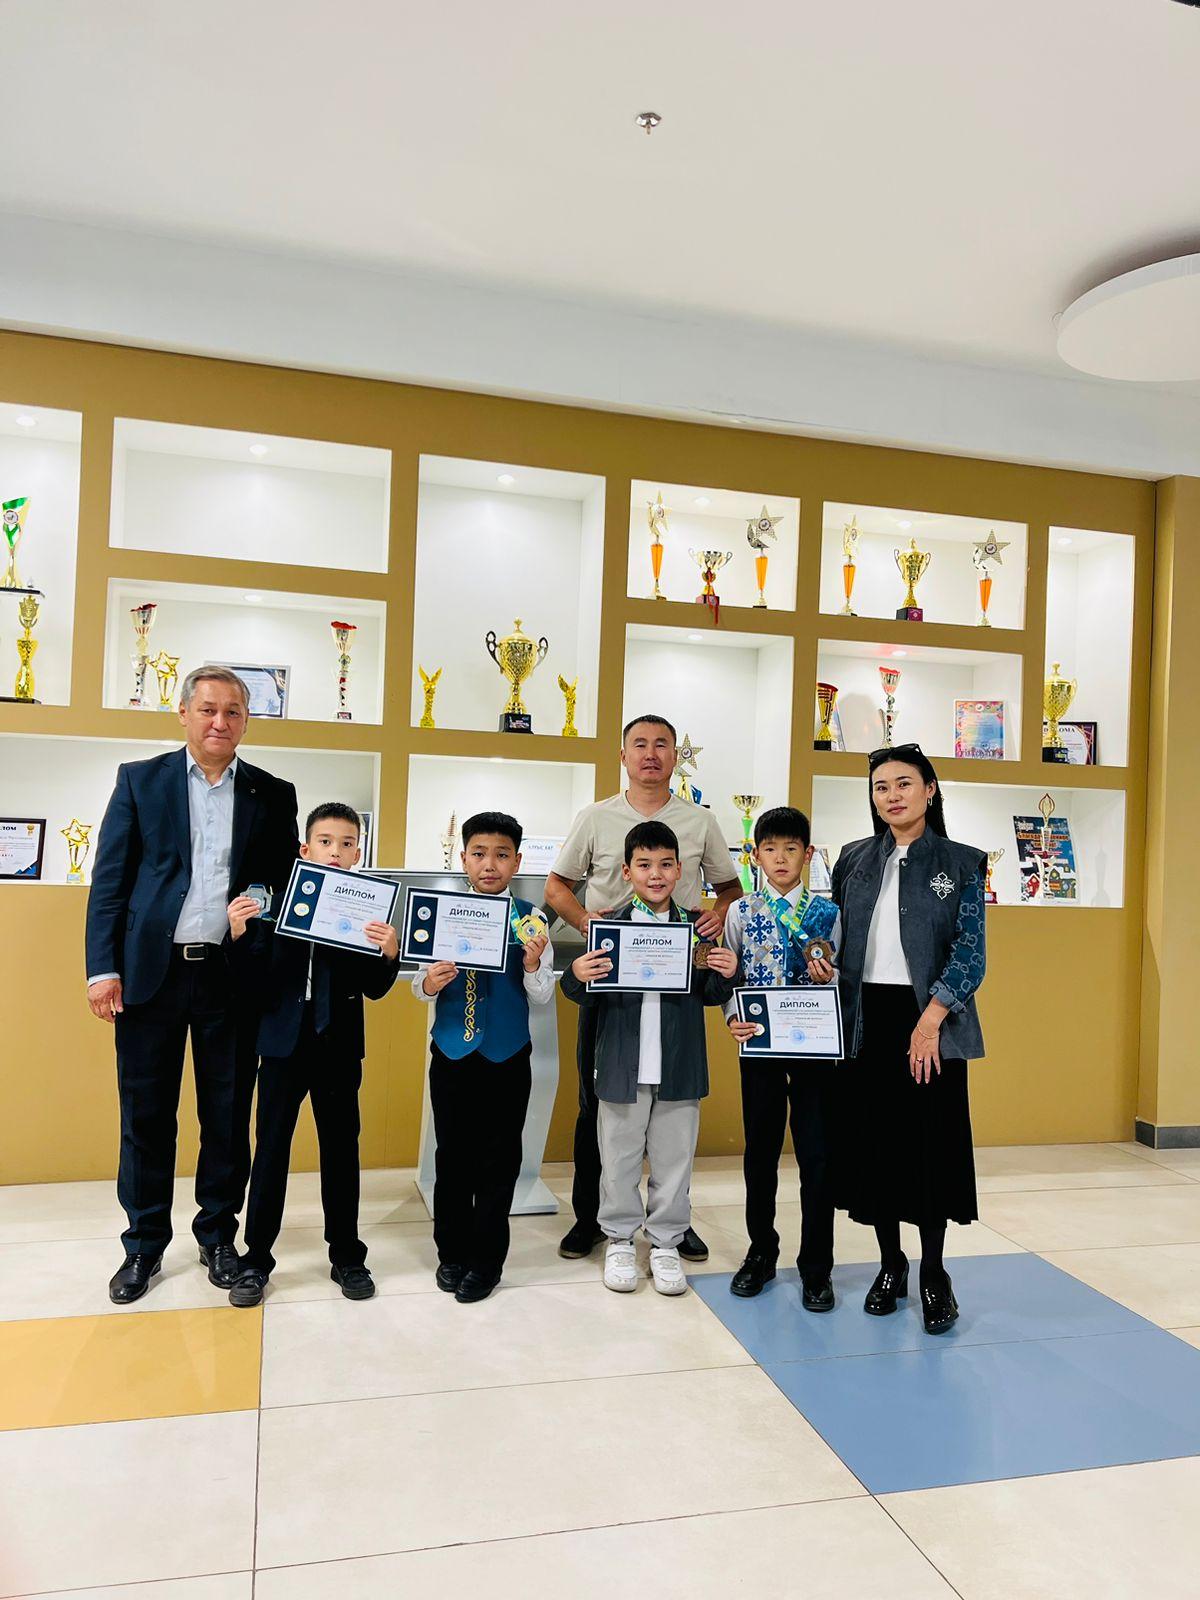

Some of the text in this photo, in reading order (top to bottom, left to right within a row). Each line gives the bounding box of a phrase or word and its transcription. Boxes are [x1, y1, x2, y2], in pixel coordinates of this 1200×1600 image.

[334, 886, 376, 901] ДИПЛОМ
[449, 908, 490, 918] ДИПЛОМ
[632, 938, 672, 946] ДИПЛОМ
[780, 1001, 820, 1009] ДИПЛОМ
